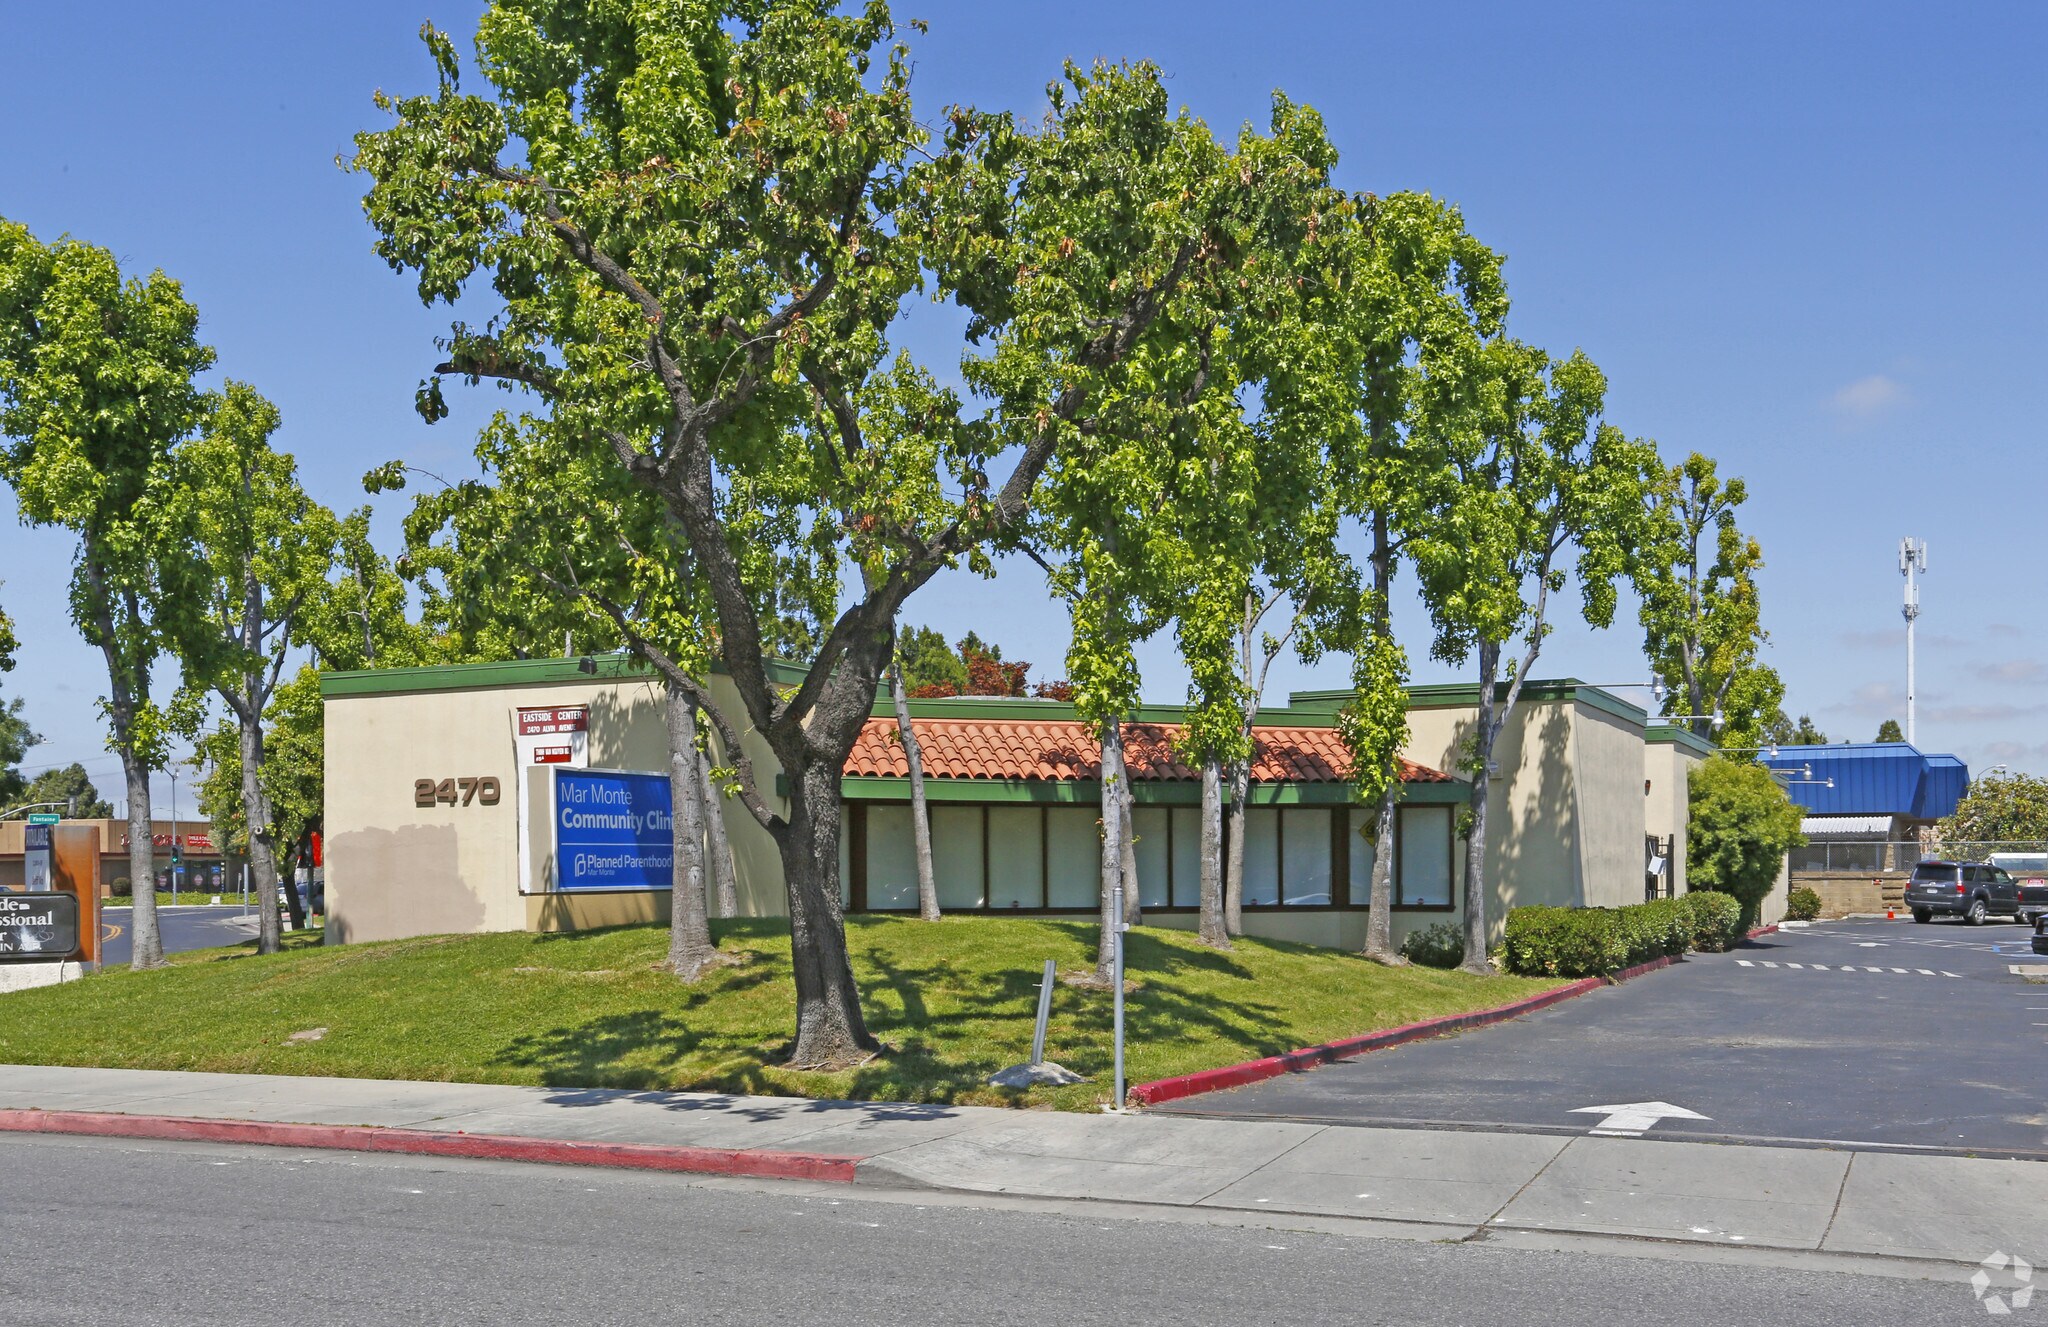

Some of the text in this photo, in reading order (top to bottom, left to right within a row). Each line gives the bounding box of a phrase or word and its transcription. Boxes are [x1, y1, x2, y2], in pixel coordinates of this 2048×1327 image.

[523, 711, 582, 722] EASTSIDE CENTER
[526, 725, 541, 733] 2470
[558, 723, 576, 731] AVENUE
[415, 776, 500, 807] 2470
[561, 782, 633, 805] Mar Monte
[561, 807, 674, 835] Community Clini
[587, 854, 672, 868] Planned Parenthood
[0, 910, 53, 926] sional
[0, 942, 13, 951] IN
